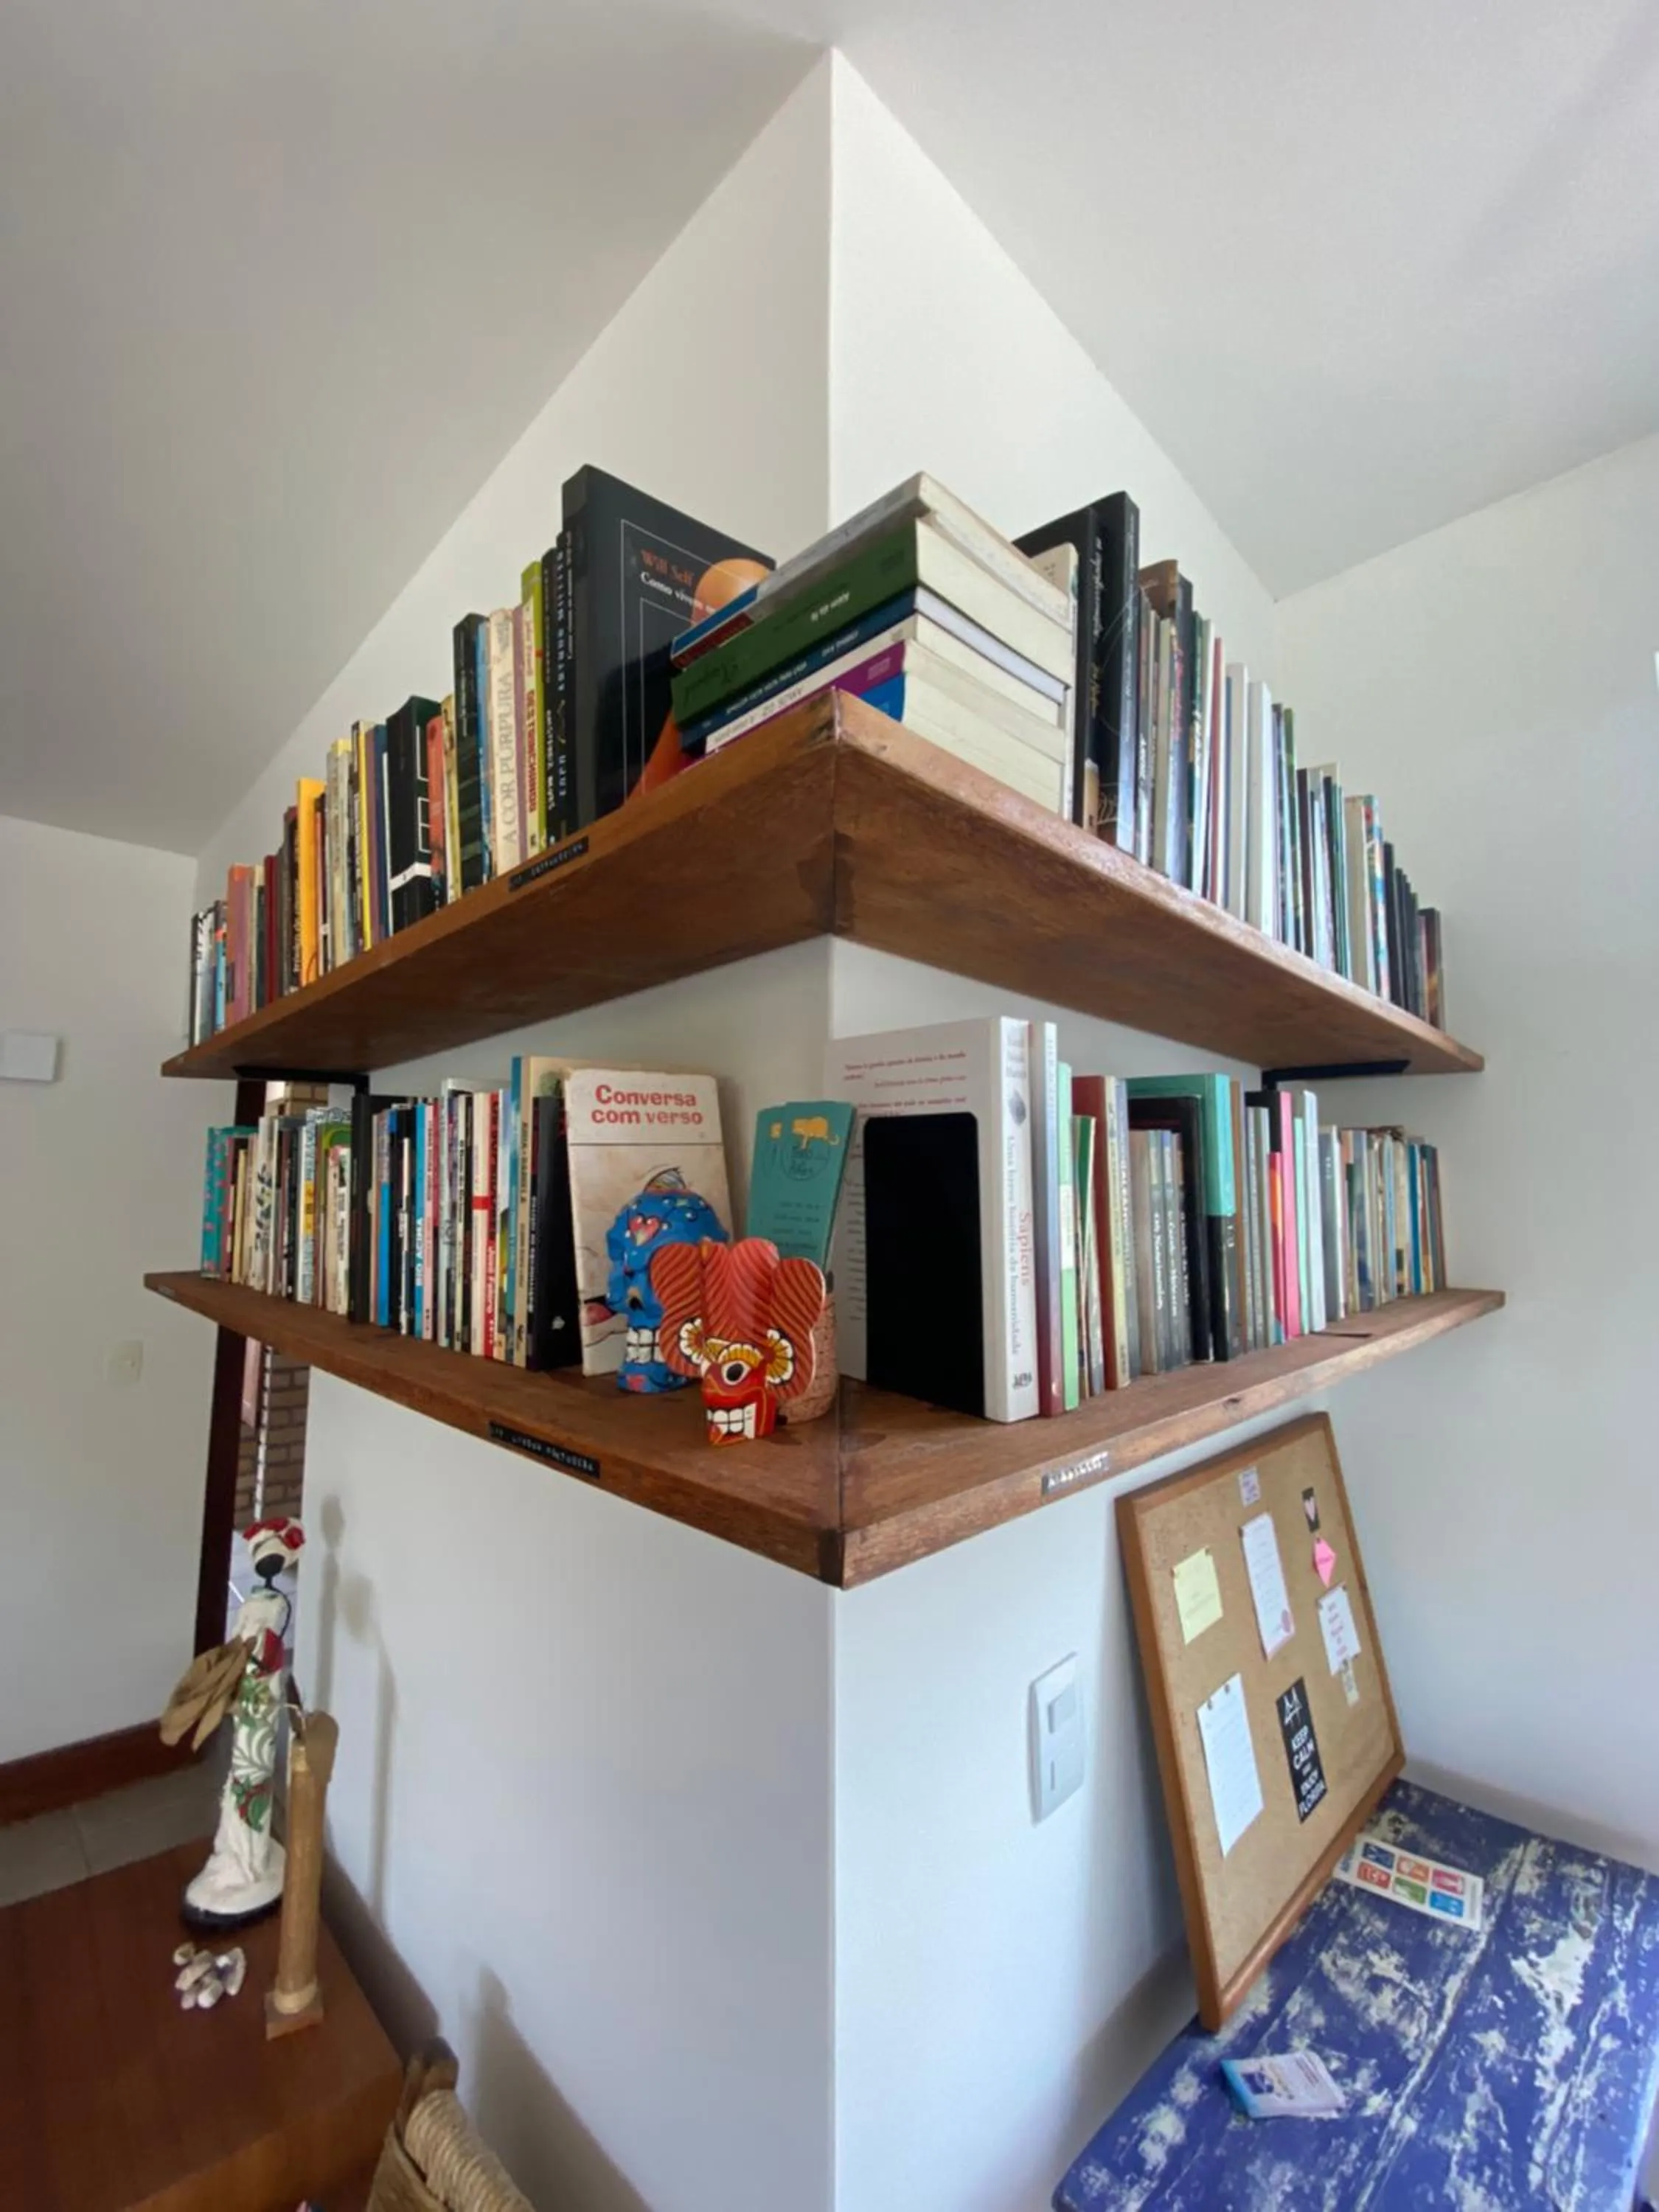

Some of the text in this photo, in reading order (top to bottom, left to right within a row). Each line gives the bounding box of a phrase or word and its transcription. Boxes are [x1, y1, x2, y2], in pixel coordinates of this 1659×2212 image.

[640, 571, 672, 596] Como
[501, 785, 516, 827] COR
[502, 831, 517, 844] A
[594, 1083, 697, 1107] Conversa
[591, 1109, 703, 1125] com verso
[1018, 1211, 1032, 1287] Sapiens
[1010, 1275, 1022, 1356] humanidade
[1293, 1739, 1315, 1770] CALM
